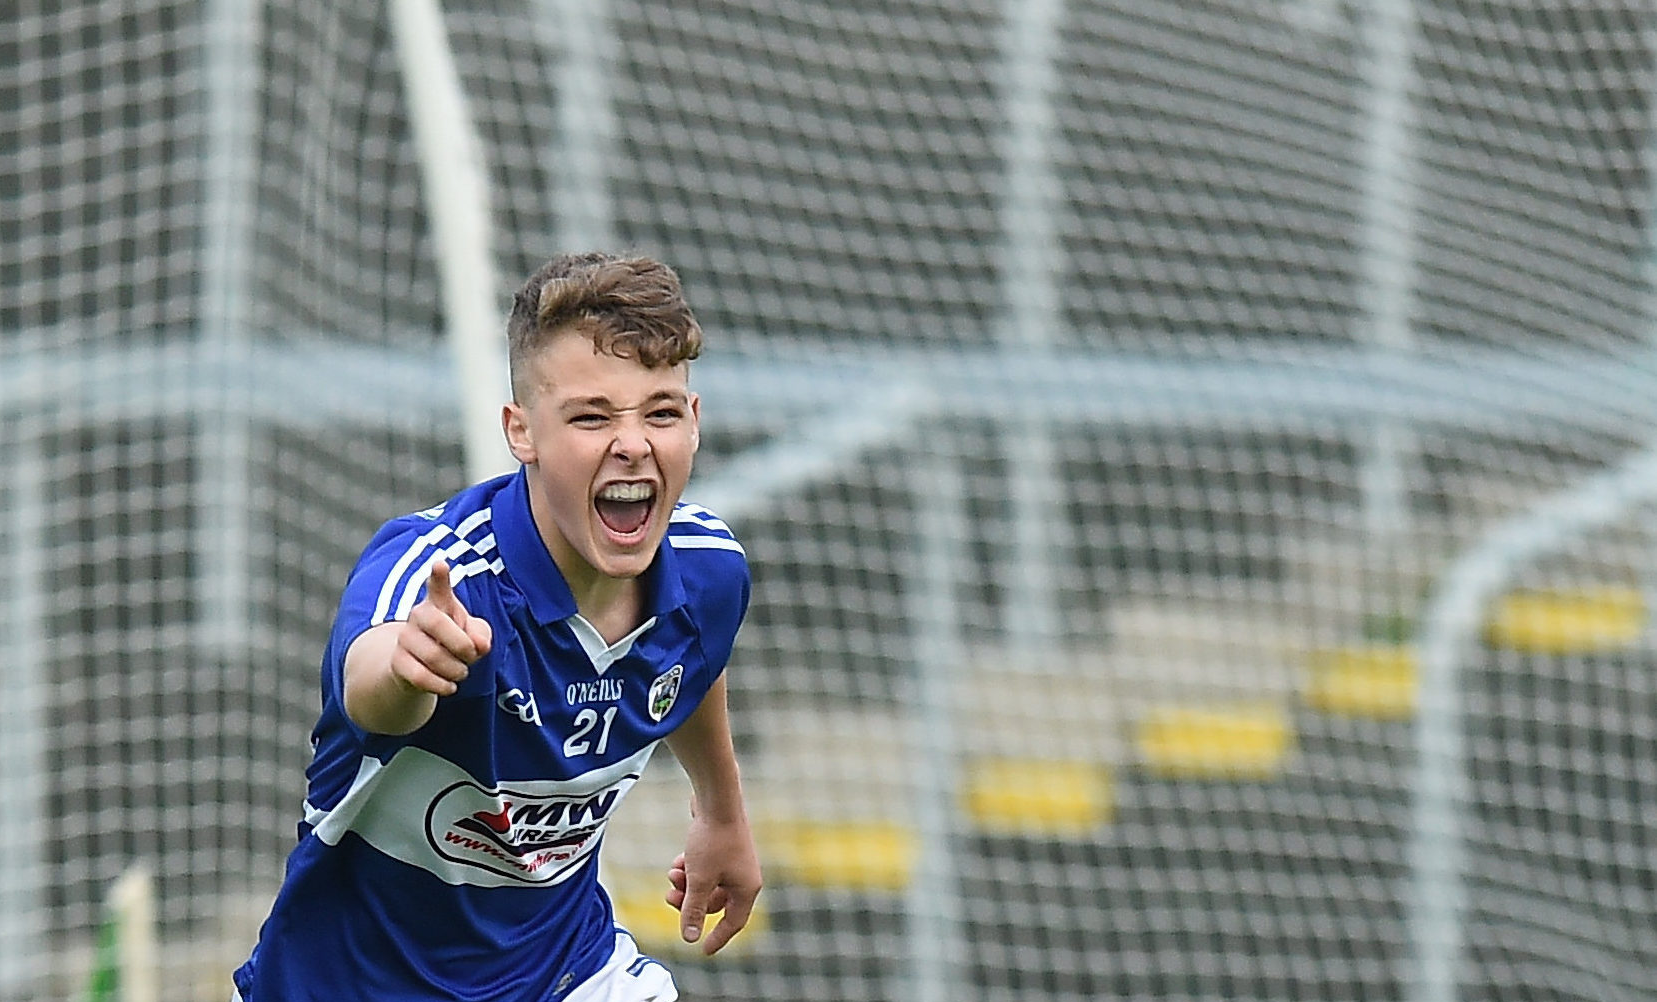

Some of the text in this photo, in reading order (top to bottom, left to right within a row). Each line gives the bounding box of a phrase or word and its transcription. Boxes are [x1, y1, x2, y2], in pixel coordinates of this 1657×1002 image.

[566, 678, 625, 706] O'NEILLS
[563, 706, 619, 758] 21
[511, 789, 620, 827] MW
